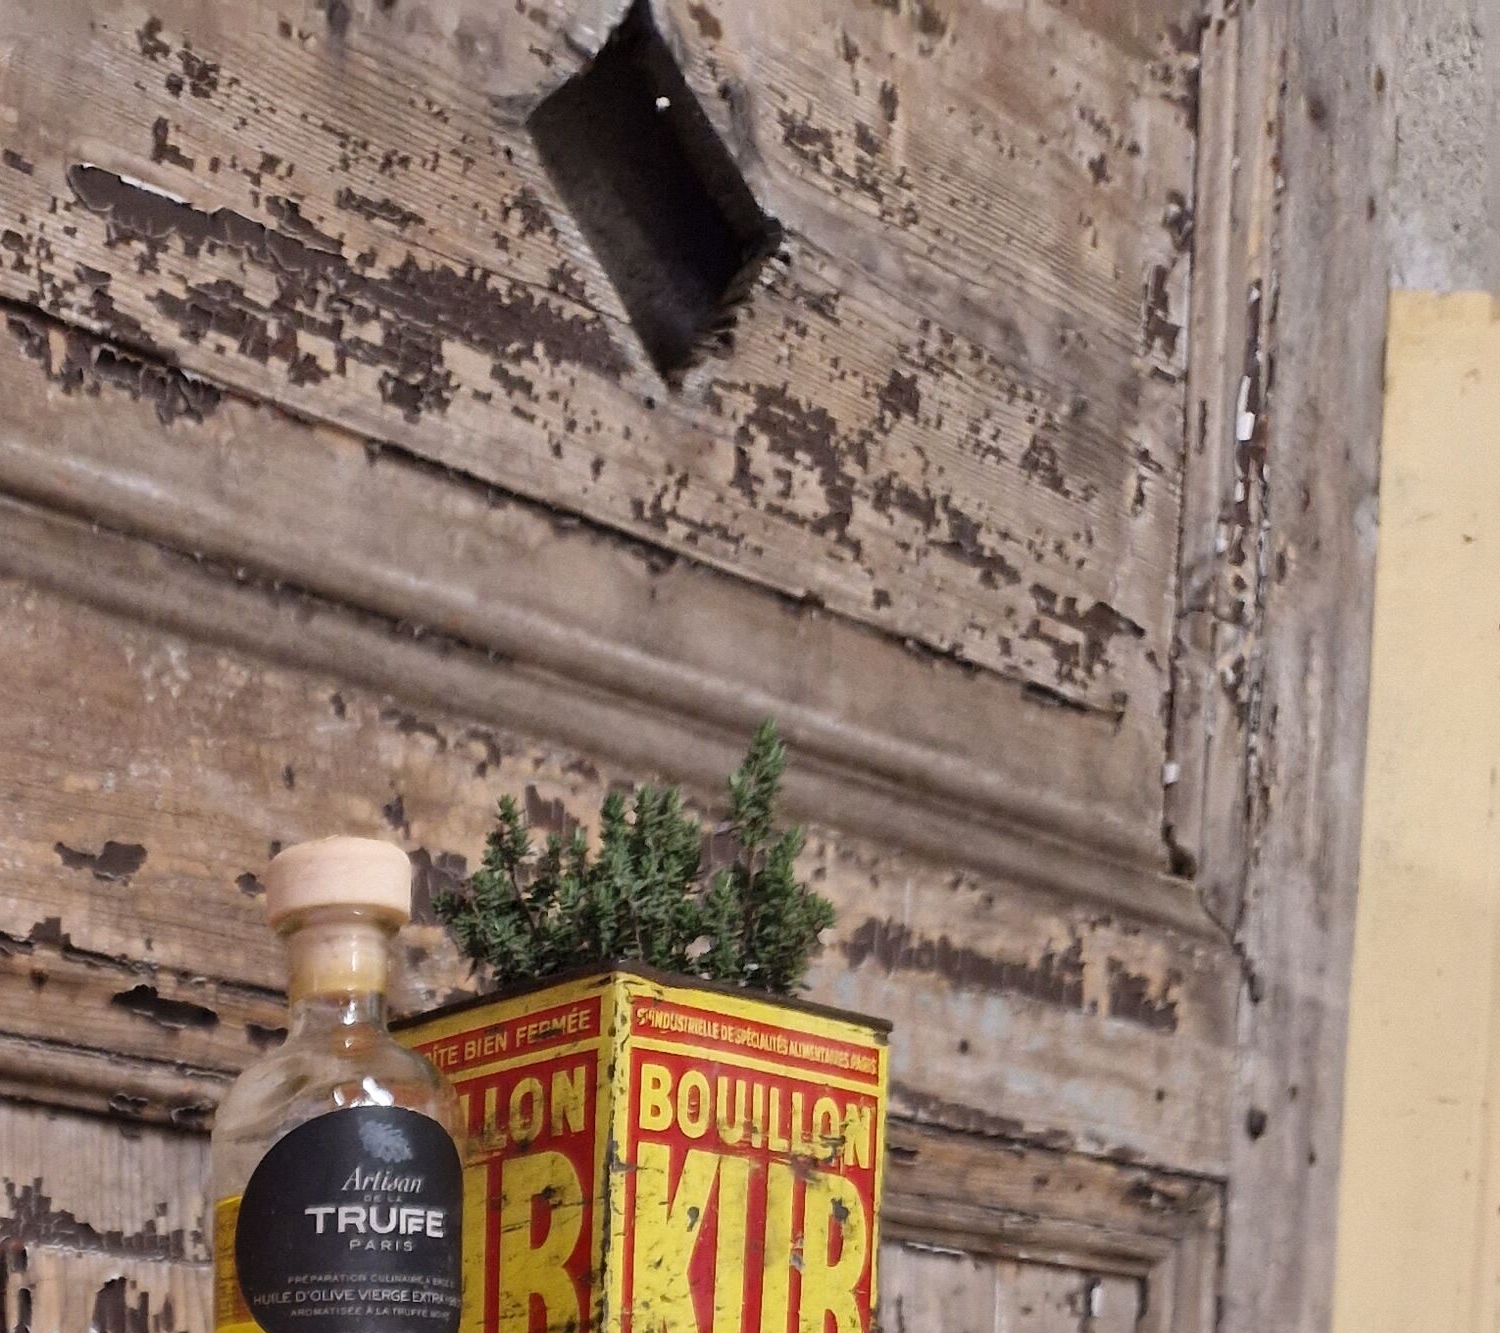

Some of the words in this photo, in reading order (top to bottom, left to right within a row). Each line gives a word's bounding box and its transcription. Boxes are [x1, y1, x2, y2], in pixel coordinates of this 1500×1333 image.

[464, 1031, 508, 1061] BIEN
[516, 1007, 592, 1048] FERMÉE
[720, 1024, 735, 1043] DE
[638, 1063, 872, 1170] BOUILLON
[341, 1165, 422, 1193] Artisan
[363, 1194, 382, 1203] DE
[304, 1206, 444, 1239] TRUFFE
[349, 1239, 413, 1252] PARIS
[287, 1272, 367, 1284] PRÉPARATION
[253, 1291, 292, 1306] HUILE
[295, 1288, 355, 1302] D'OLIVE
[358, 1288, 411, 1302] VIERGE
[412, 1290, 444, 1304] EXTRA
[290, 1305, 362, 1317] AROMATISÉE
[376, 1306, 389, 1316] LA
[392, 1307, 428, 1318] TRUFFE
